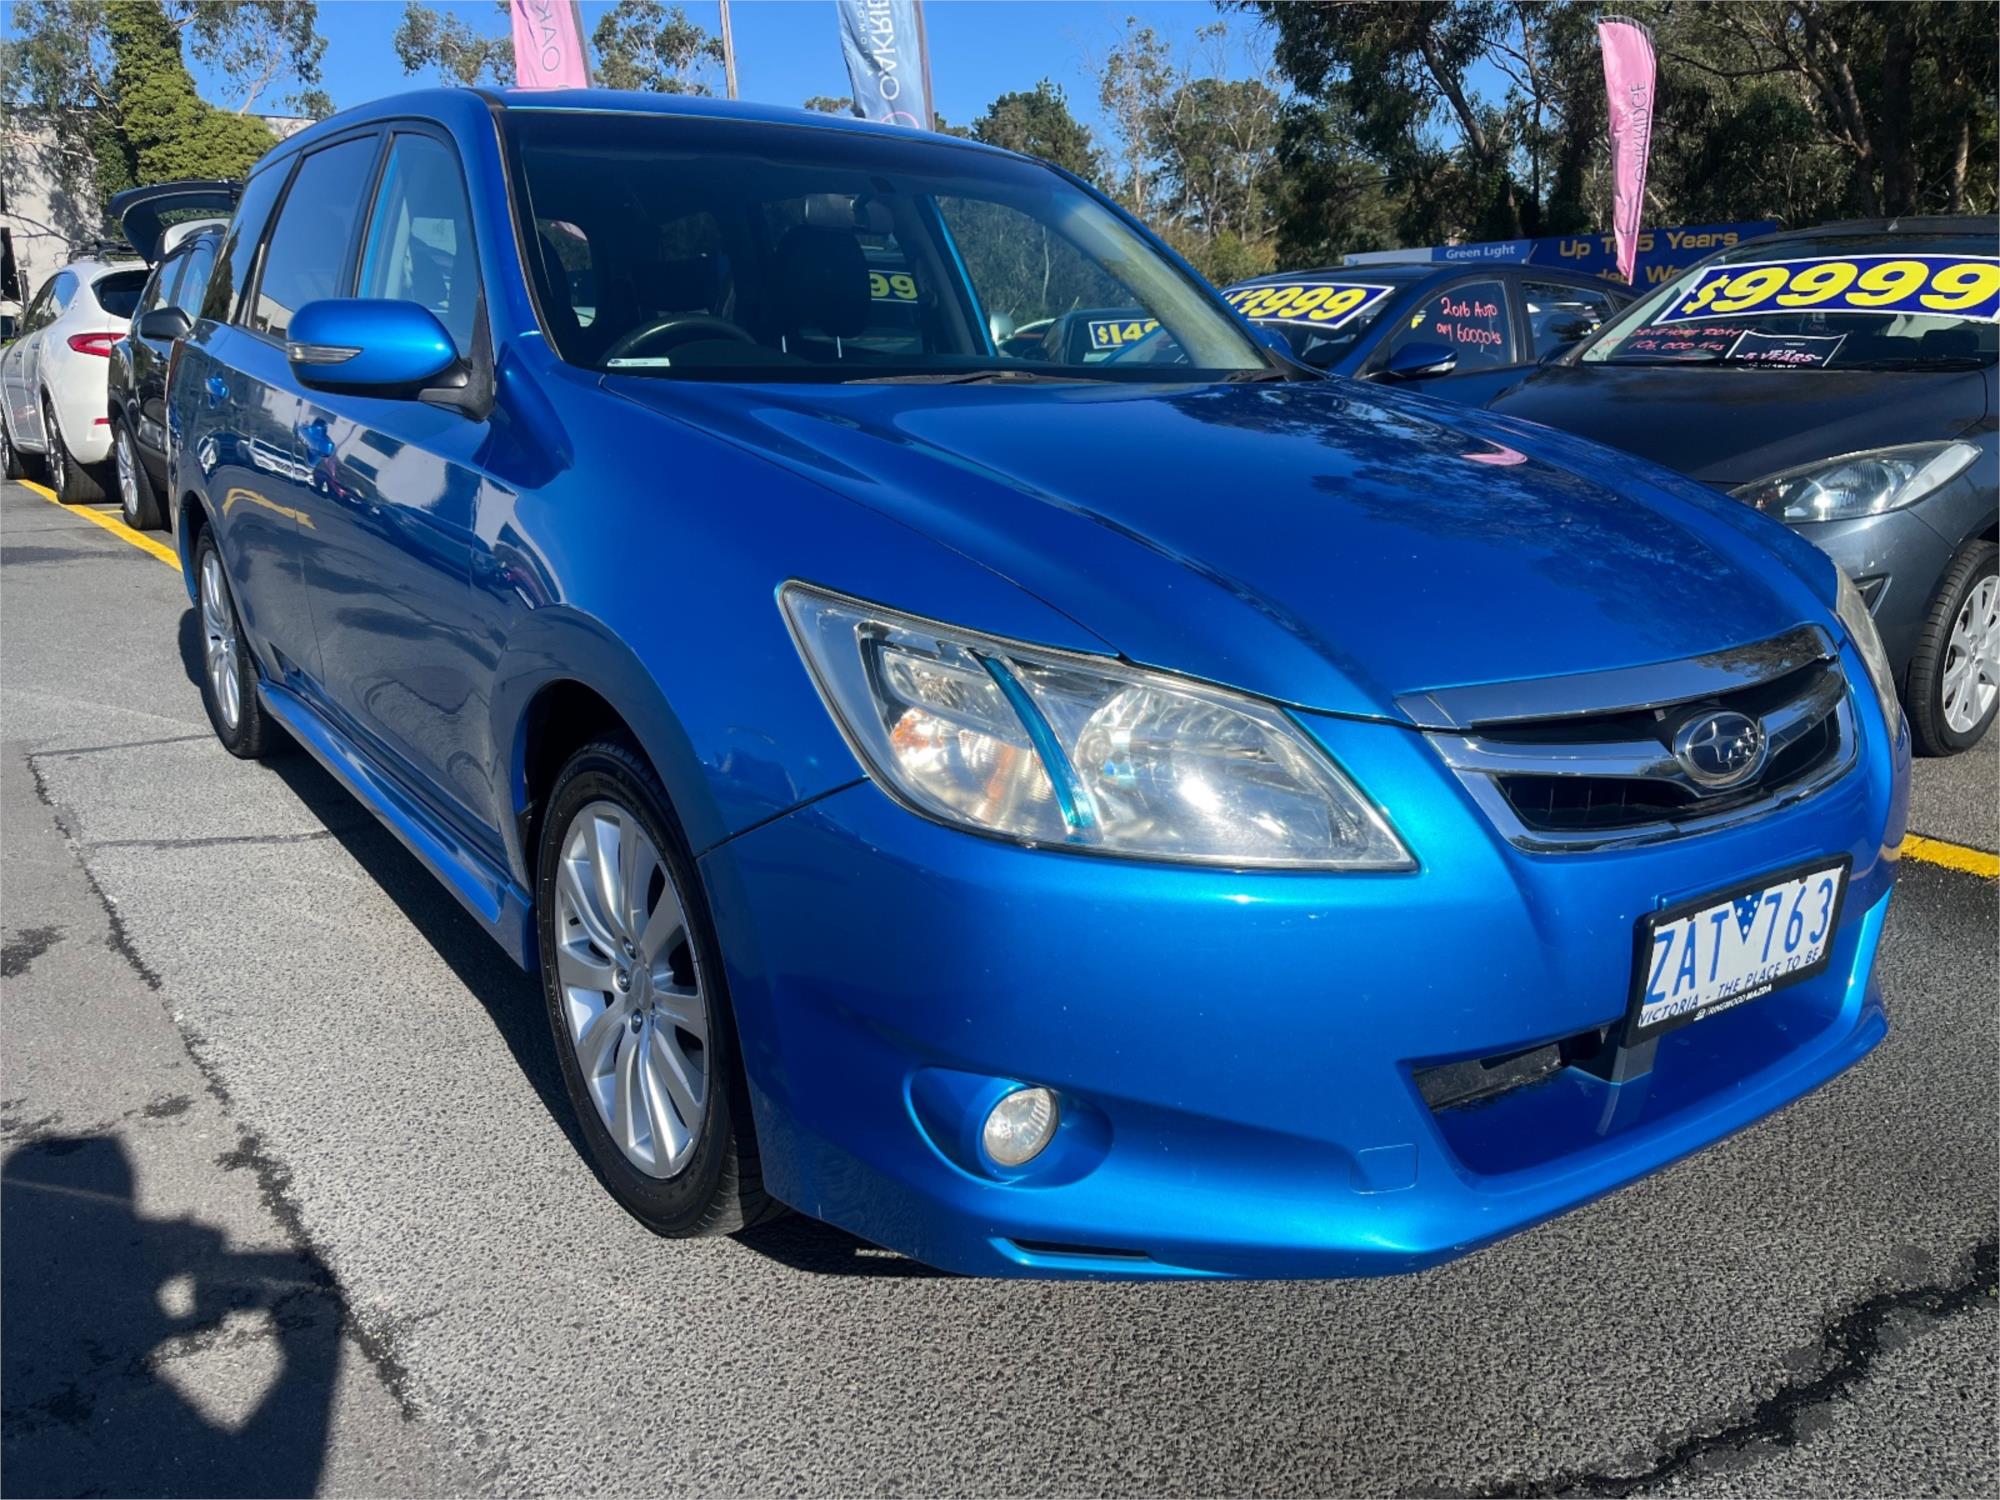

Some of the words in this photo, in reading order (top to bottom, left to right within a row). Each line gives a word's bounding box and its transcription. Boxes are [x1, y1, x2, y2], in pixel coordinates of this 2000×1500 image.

[1446, 249, 1481, 260] Green
[1484, 245, 1516, 258] Light
[1559, 239, 1591, 260] Up
[1666, 231, 1739, 250] Years
[1441, 296, 1471, 317] 2016
[1682, 260, 2000, 314] $9999
[1645, 910, 1730, 1006] ZAT
[1762, 878, 1833, 962] 763
[1640, 995, 1699, 1025] VICTORIA
[1718, 978, 1740, 999] THE
[1745, 962, 1781, 988] PLACE
[1786, 954, 1801, 973] TO
[1805, 946, 1819, 964] BE
